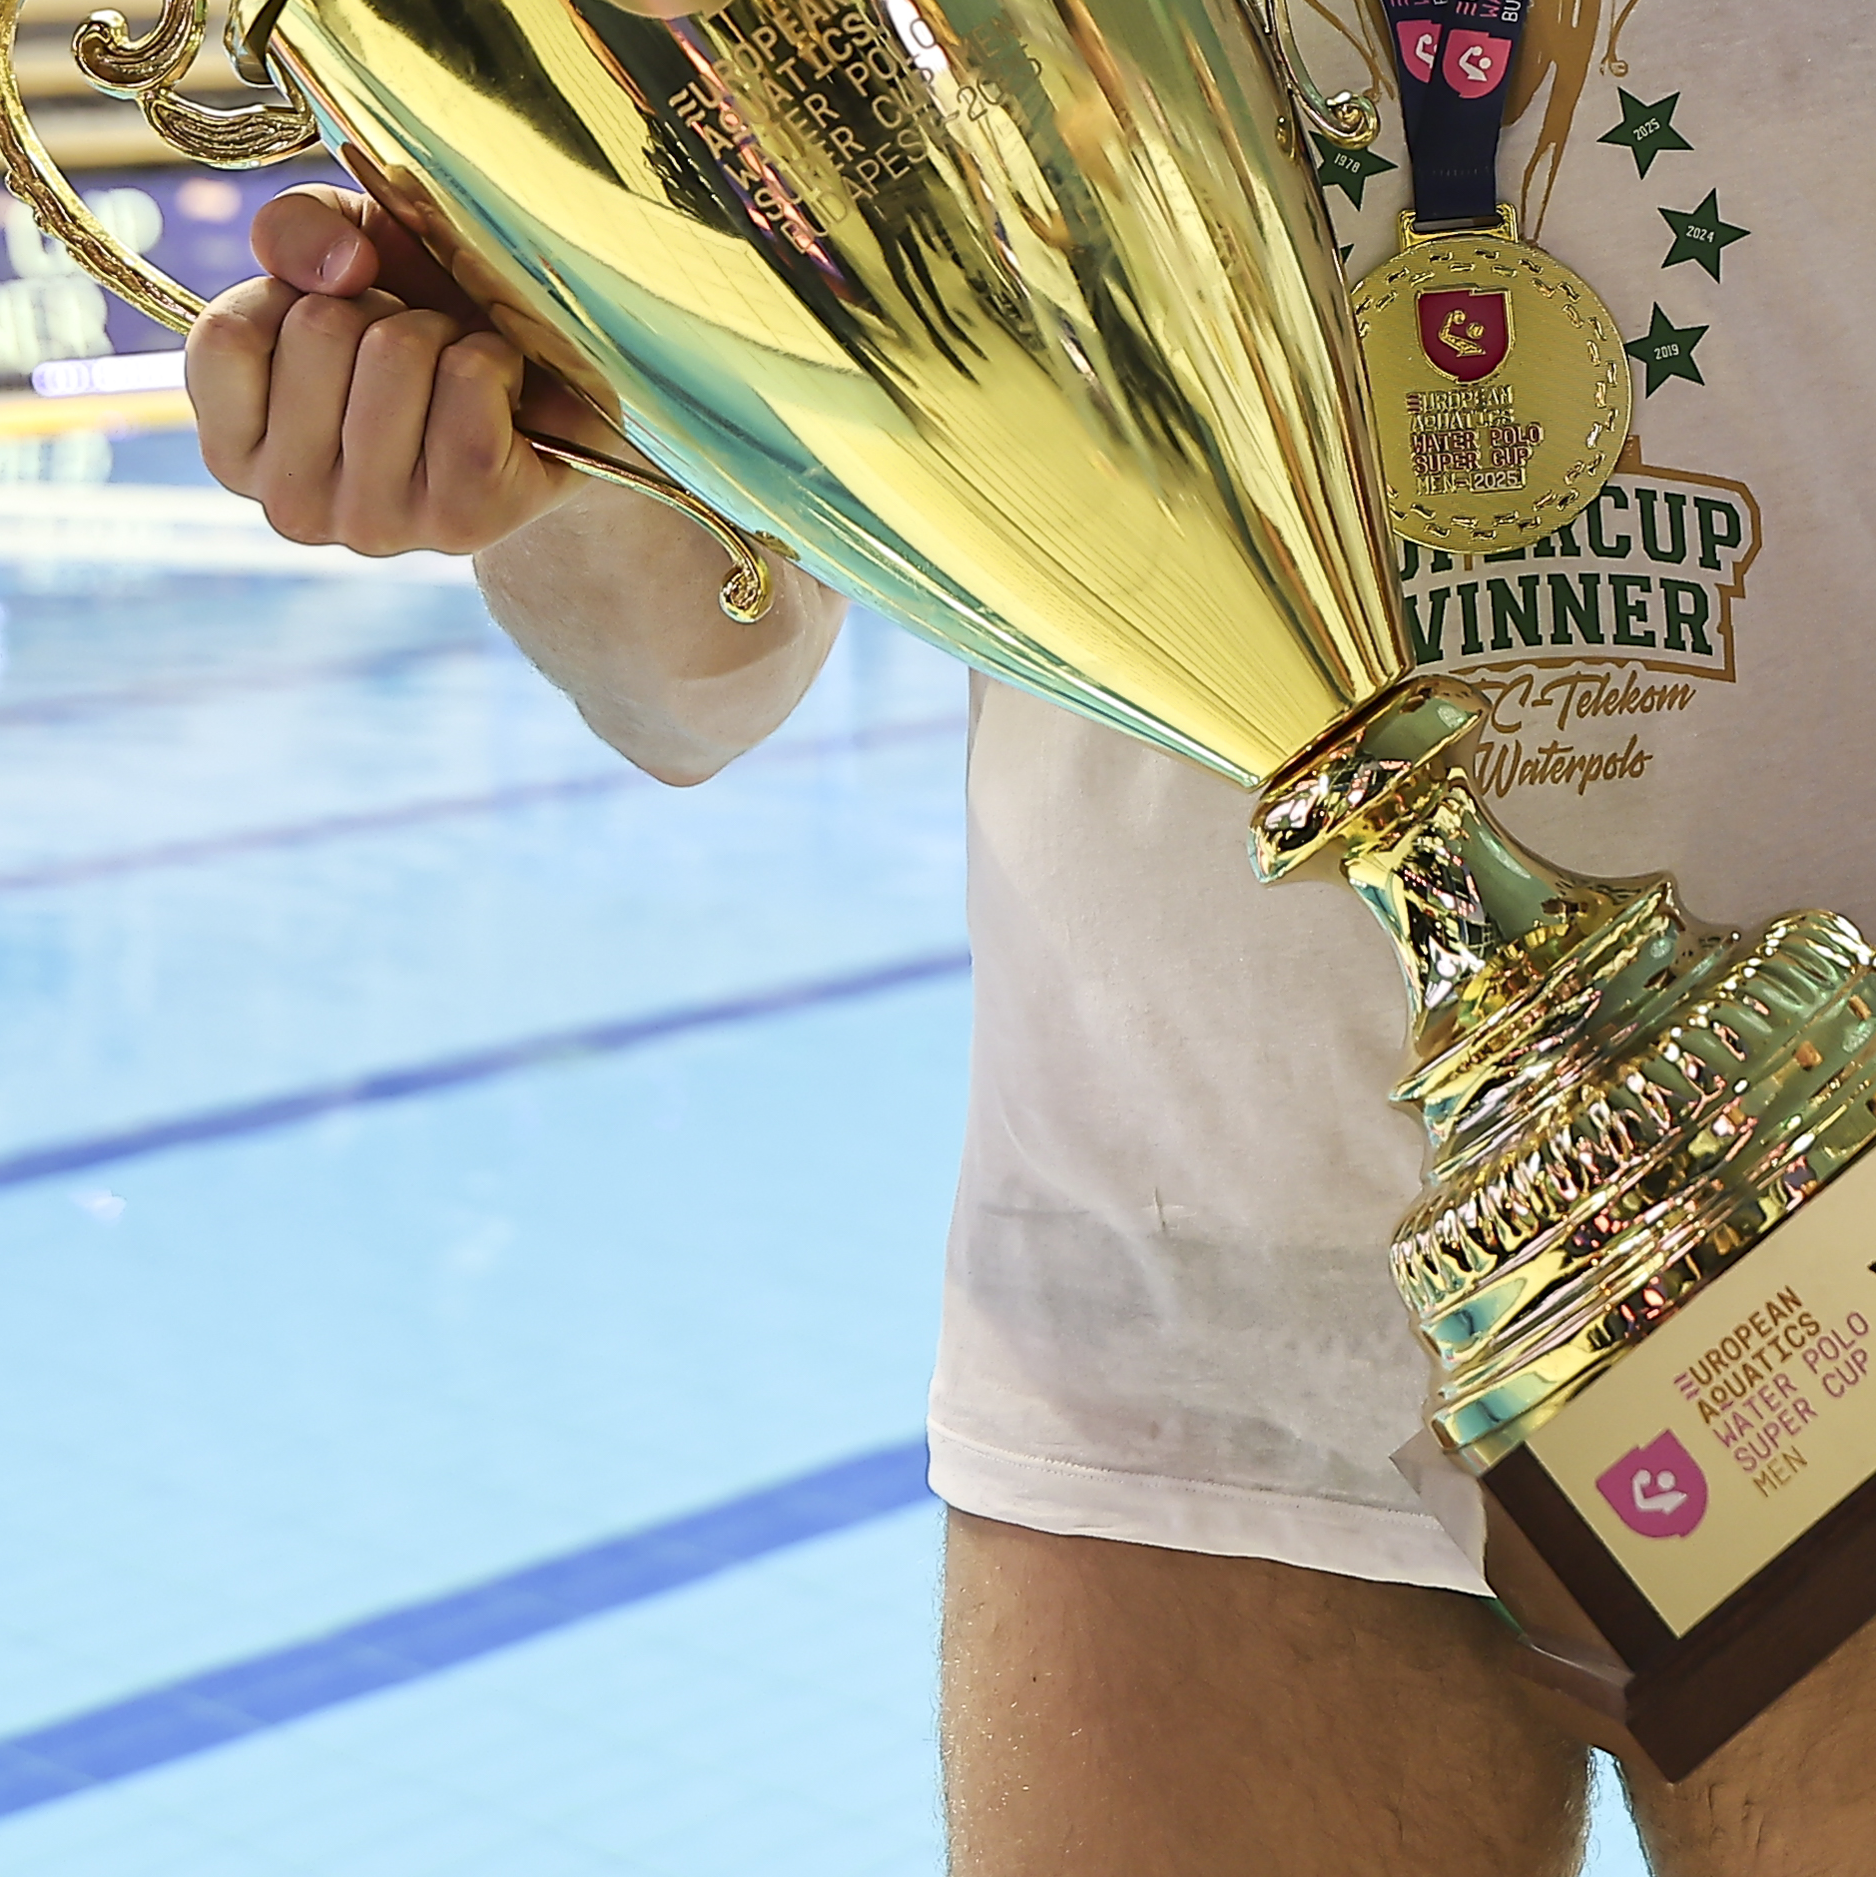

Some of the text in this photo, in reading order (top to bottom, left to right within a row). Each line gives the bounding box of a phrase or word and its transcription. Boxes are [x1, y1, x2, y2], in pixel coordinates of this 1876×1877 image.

[703, 12, 875, 159] AQUATICS
[723, 93, 840, 192] WAER
[1632, 118, 1661, 141] 2025
[754, 125, 866, 222] SUR
[1333, 152, 1361, 174] 1978
[1685, 224, 1715, 243] 2024
[1653, 343, 1680, 361] 2019
[1405, 385, 1514, 414] EUROPEAN
[1411, 422, 1545, 454] WATER POLO
[1413, 446, 1533, 475] SUPER CUP
[1475, 733, 1654, 799] Waterpolo
[1674, 1284, 1803, 1401] EUROPEAN
[1697, 1311, 1821, 1425] AQUATICS
[1712, 1311, 1869, 1448] WATER POLO
[1733, 1348, 1869, 1472] SUPER CUP
[1752, 1445, 1808, 1498] MEN
